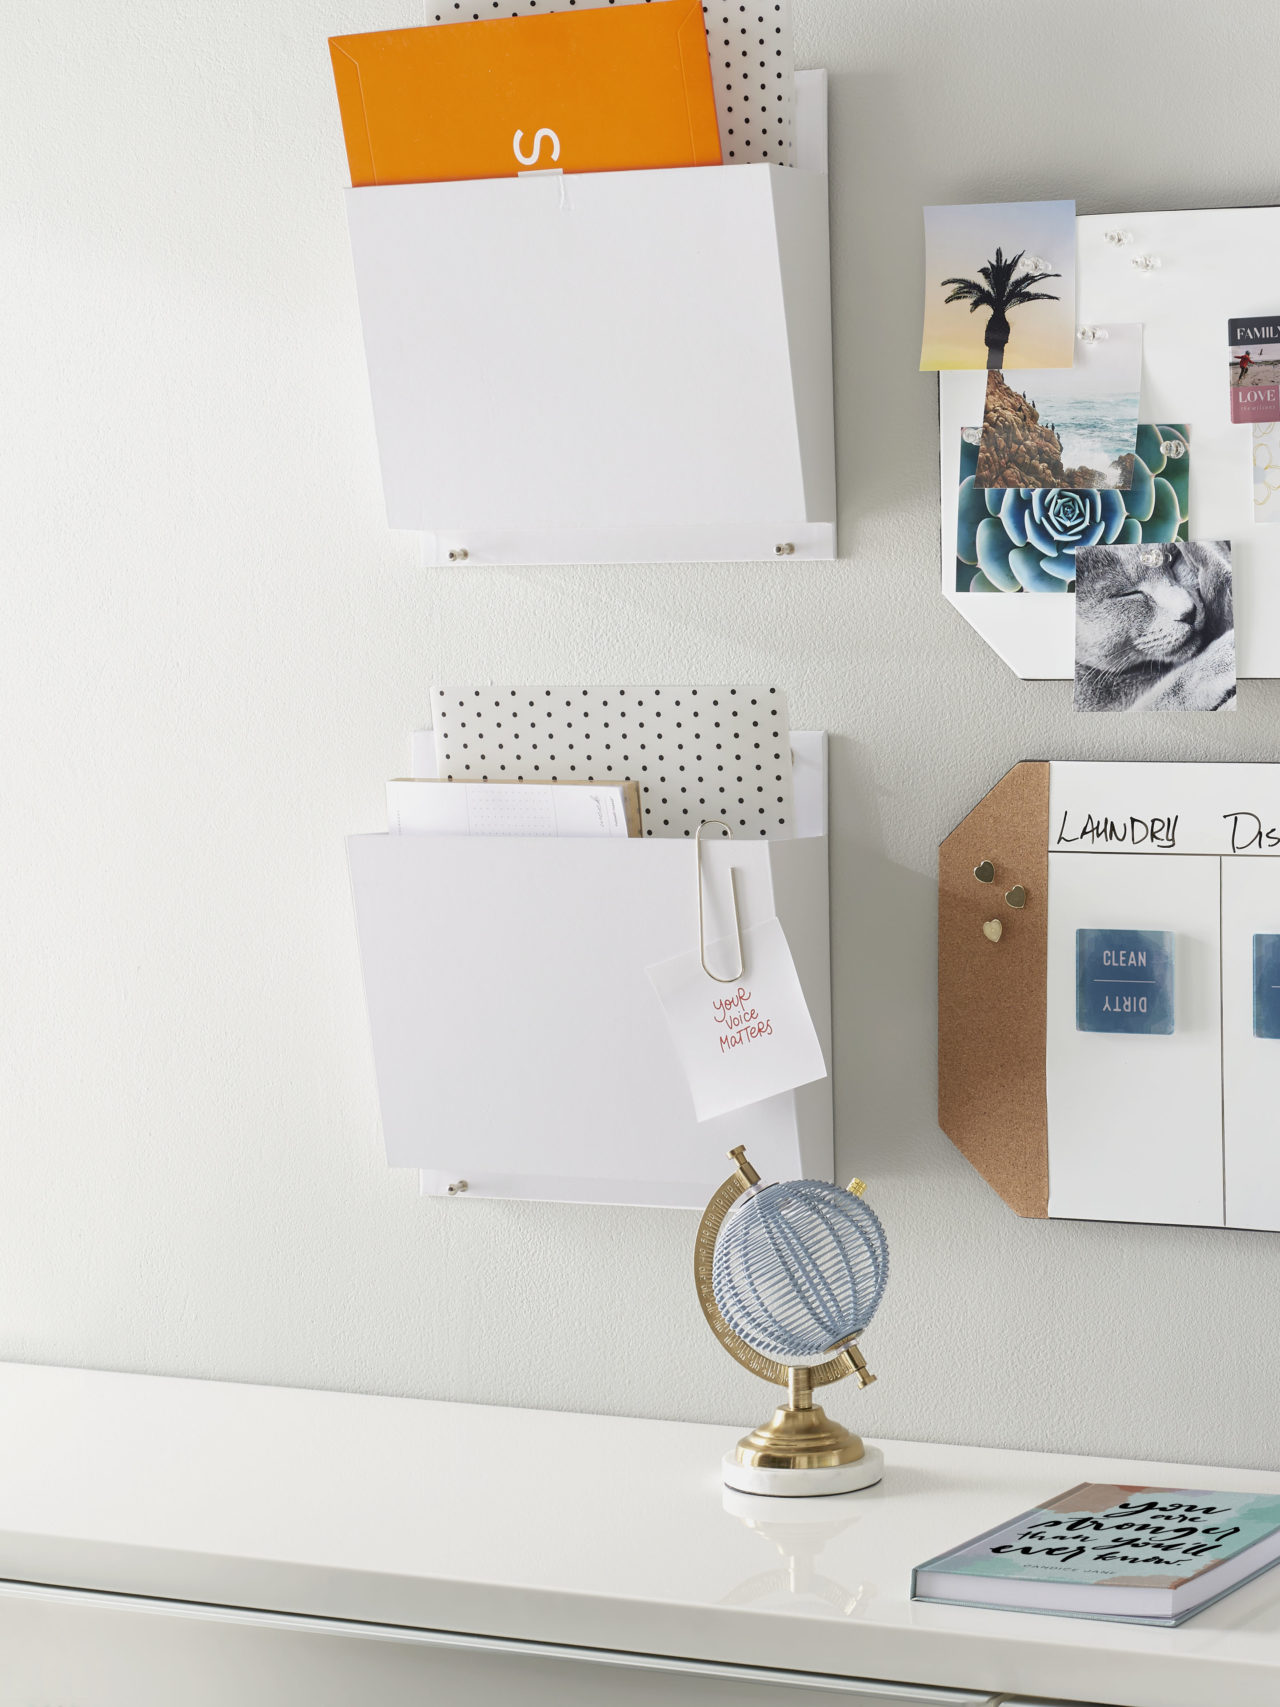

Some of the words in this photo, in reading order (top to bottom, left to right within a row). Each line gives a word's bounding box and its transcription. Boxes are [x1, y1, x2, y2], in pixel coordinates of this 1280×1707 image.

[1238, 389, 1276, 403] LOVE
[1056, 810, 1179, 849] LAUNDRY
[1103, 950, 1147, 967] CLEAN
[1102, 995, 1148, 1013] DIRTY
[1103, 1501, 1232, 1518] you
[1150, 1514, 1208, 1523] are
[1027, 1516, 1241, 1542] stronger
[1017, 1531, 1099, 1541] than
[1091, 1537, 1223, 1556] you'll
[989, 1545, 1086, 1563] ever
[1092, 1551, 1193, 1566] know.
